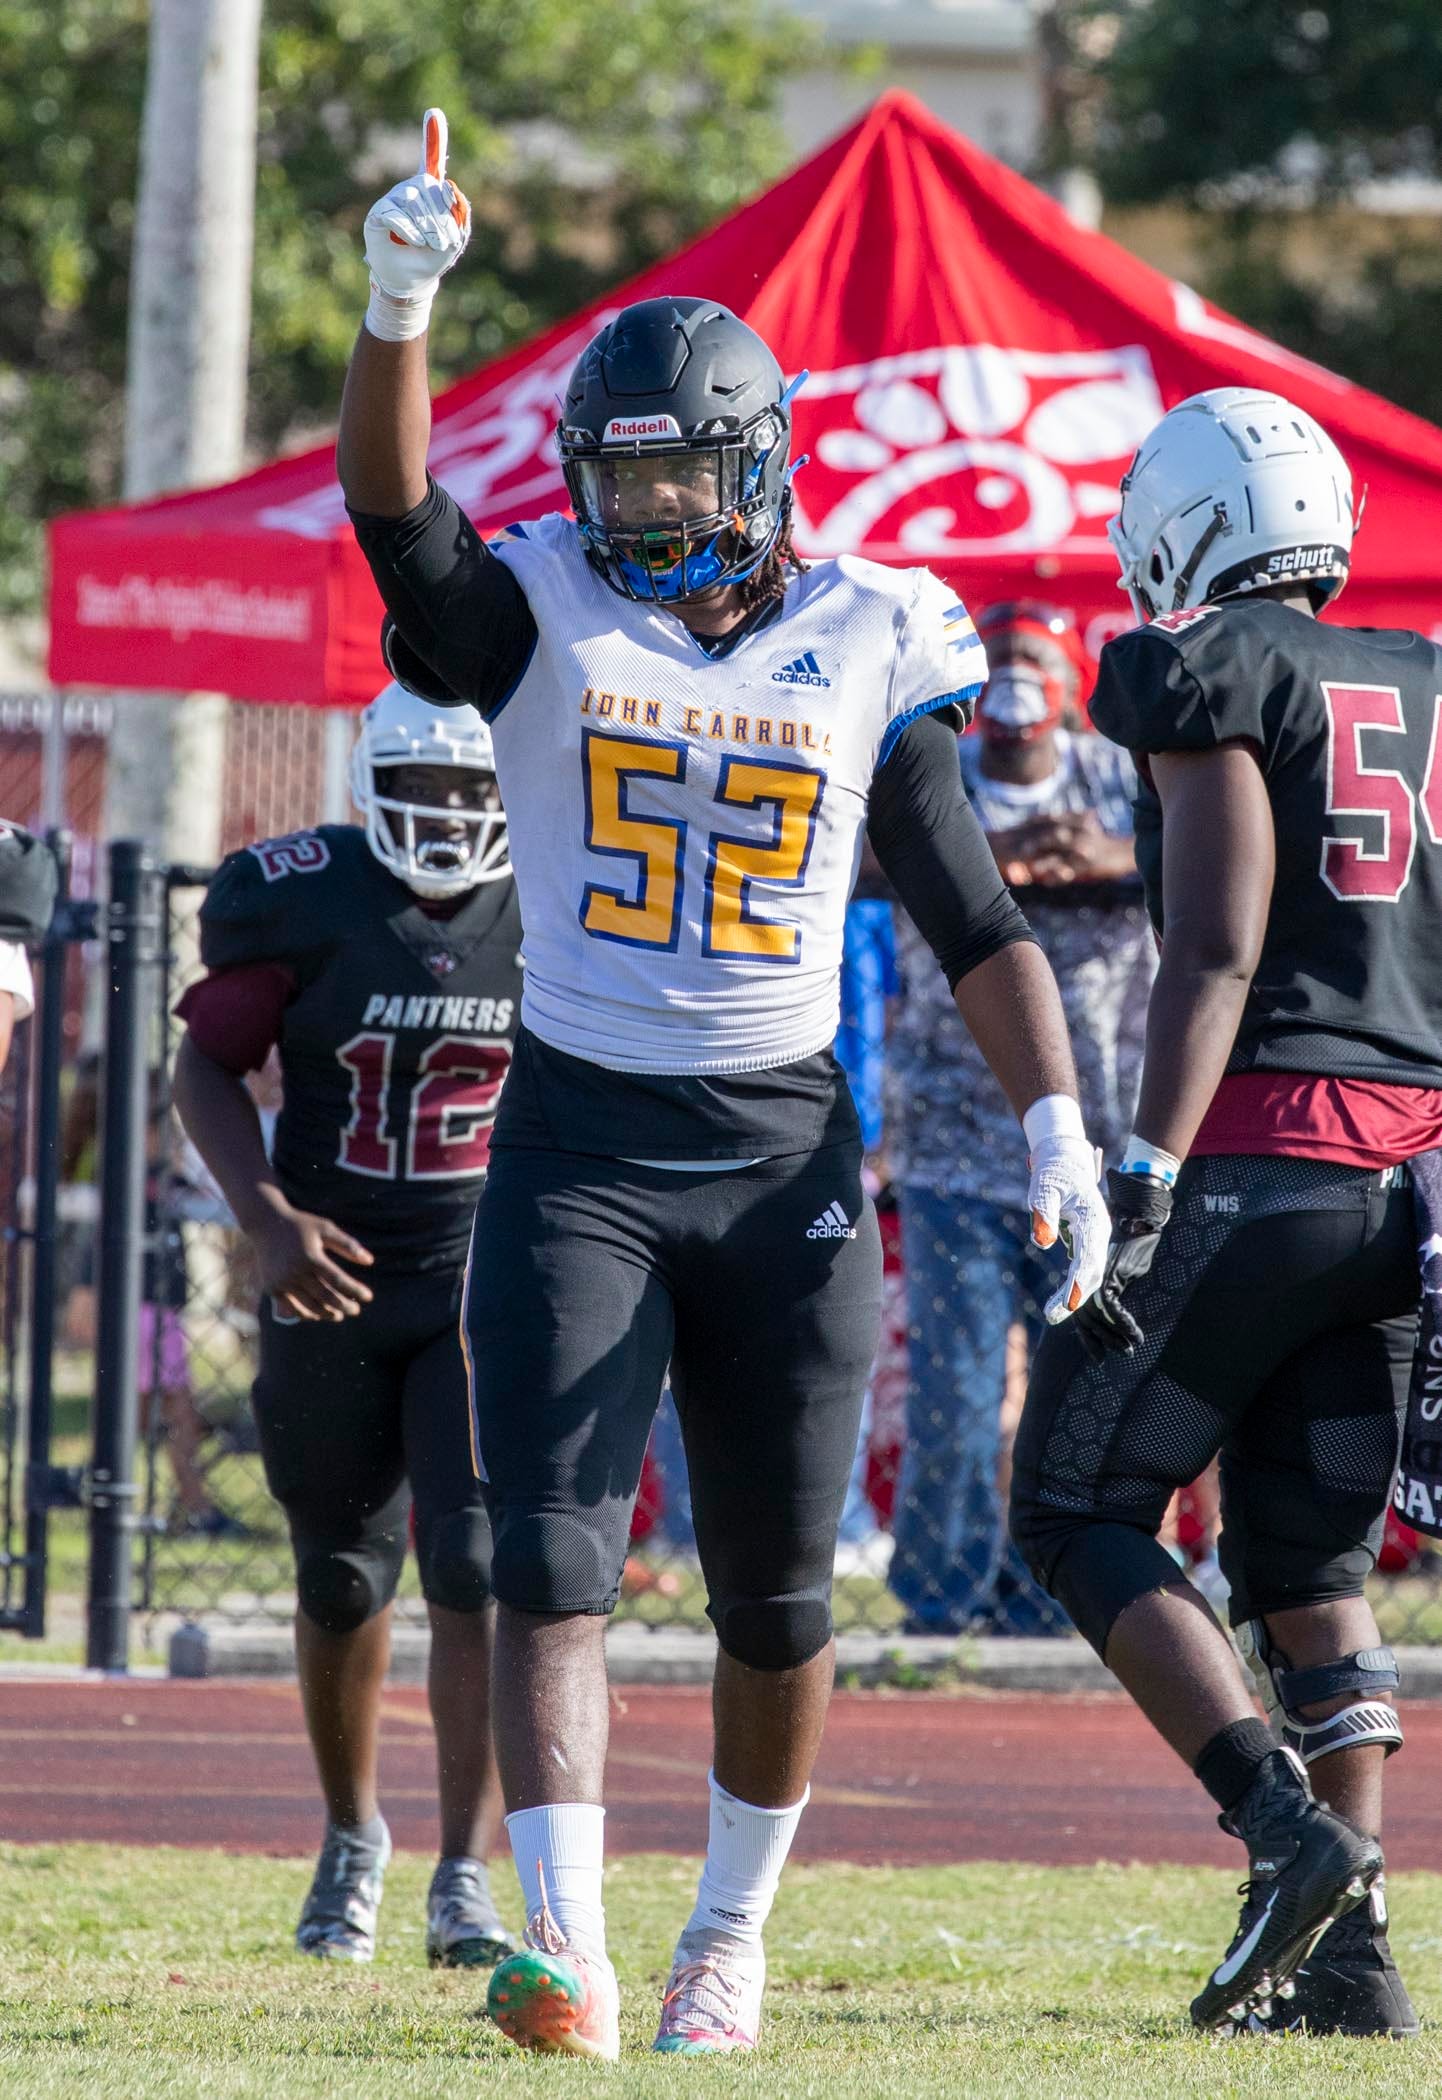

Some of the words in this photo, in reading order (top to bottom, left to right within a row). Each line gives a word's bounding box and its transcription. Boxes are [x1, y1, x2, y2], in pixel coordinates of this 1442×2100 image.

[611, 418, 668, 436] Riddell
[1267, 546, 1335, 573] schutt
[772, 671, 831, 688] adidas
[580, 687, 663, 728] JOHN
[1319, 681, 1442, 903] 5
[578, 725, 828, 965] 52
[361, 994, 515, 1031] PANTHERS
[335, 1031, 514, 1181] 12
[1203, 1194, 1240, 1212] WHS
[806, 1223, 857, 1239] adidas
